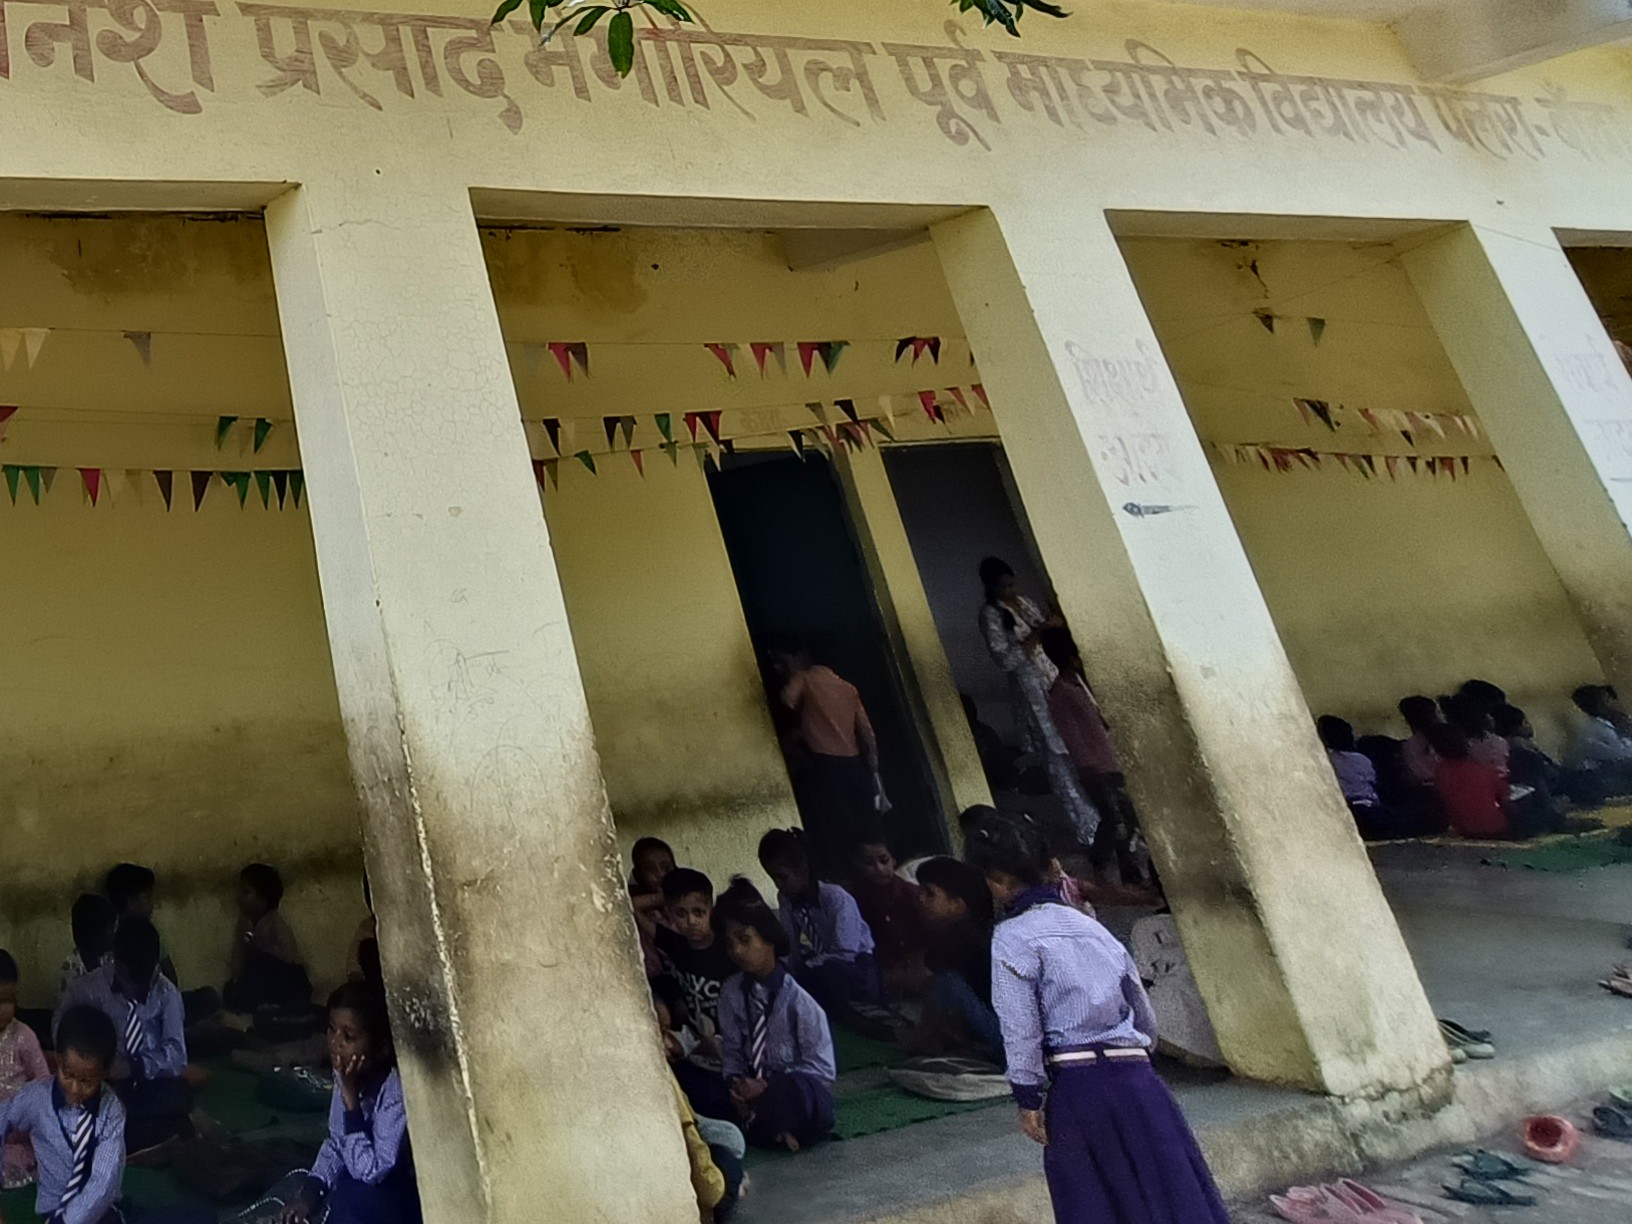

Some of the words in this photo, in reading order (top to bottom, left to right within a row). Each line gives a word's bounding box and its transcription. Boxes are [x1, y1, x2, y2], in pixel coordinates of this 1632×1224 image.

[234, 0, 524, 136] प्रसाद
[880, 18, 1002, 152] पूर्व
[989, 38, 1258, 137] माध्यमिक
[1234, 47, 1444, 154] विद्यालय
